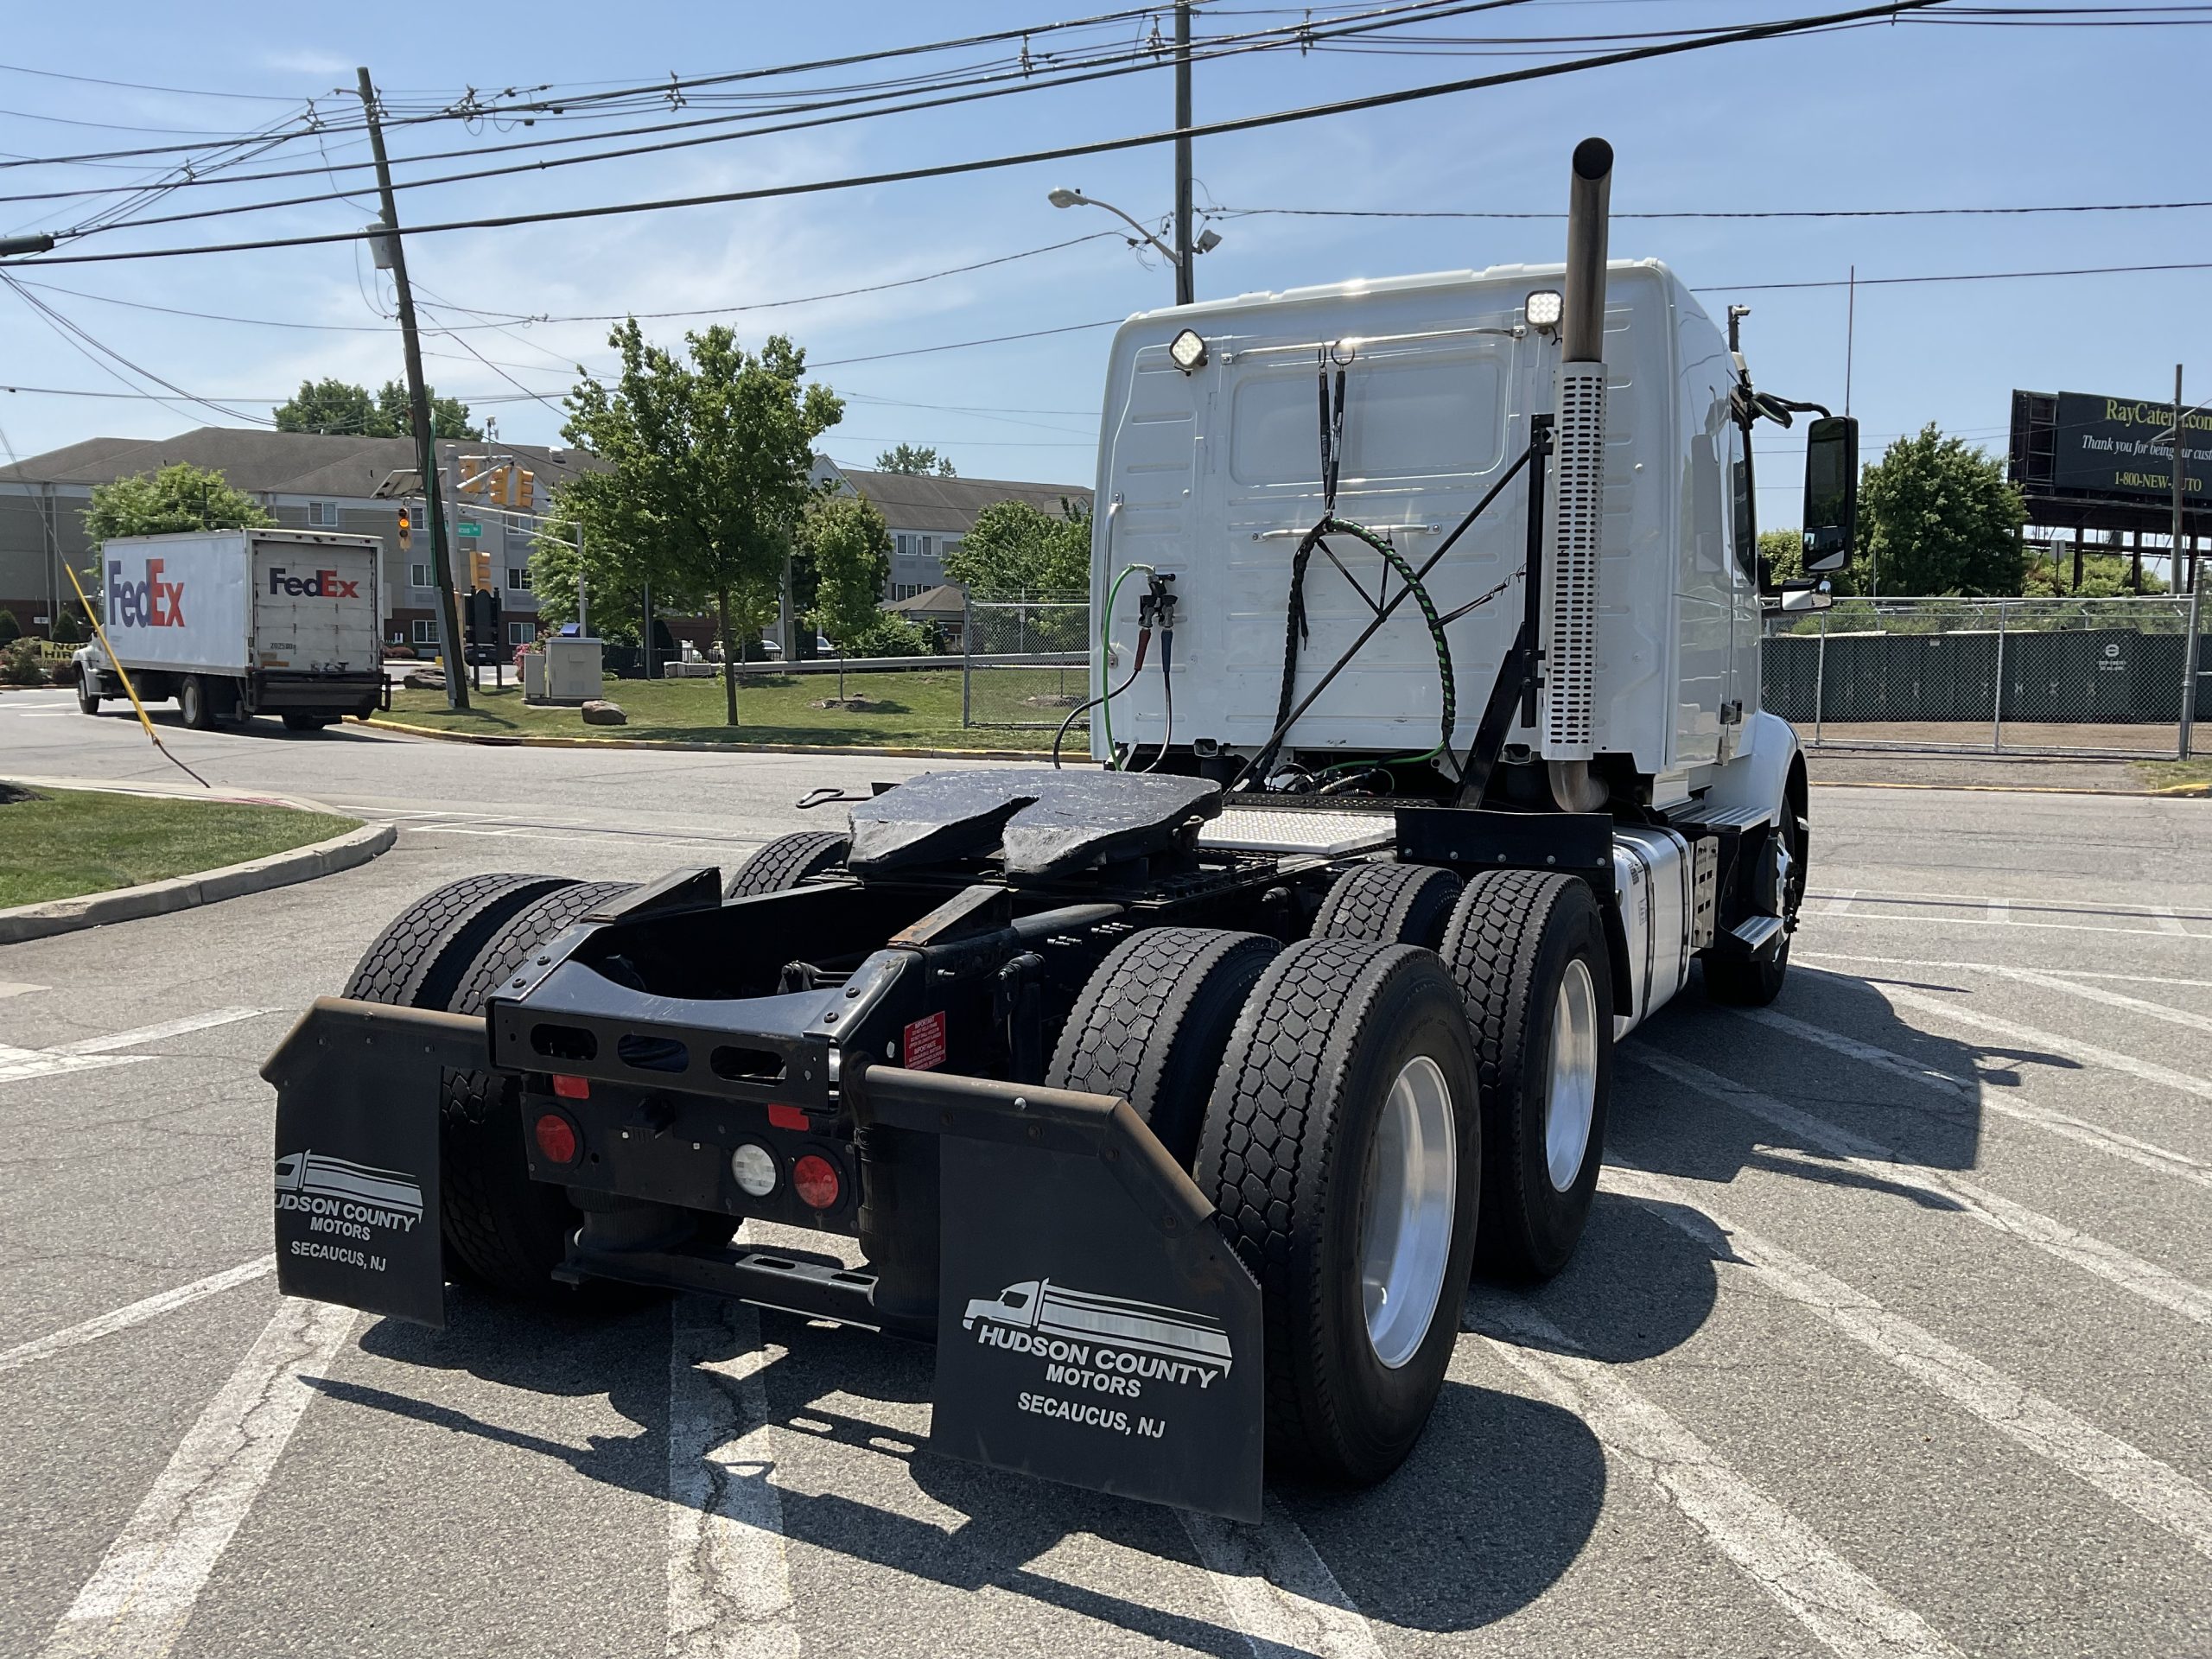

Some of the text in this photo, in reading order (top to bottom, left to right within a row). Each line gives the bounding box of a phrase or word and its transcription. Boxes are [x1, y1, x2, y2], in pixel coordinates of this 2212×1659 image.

[2082, 435, 2113, 451] Thank
[2113, 441, 2133, 454] you
[2133, 439, 2149, 456] for
[2150, 441, 2174, 461] being
[2182, 448, 2193, 458] ur
[108, 558, 185, 628] FedEx
[270, 567, 359, 598] FedEx
[44, 650, 73, 658] HIR
[275, 1192, 416, 1232] UDSON COUNTY
[310, 1217, 371, 1241] MOTORS
[290, 1241, 386, 1272] SECAUCUS, NJ
[977, 1325, 1218, 1389] HUDSON COUNTY
[1045, 1363, 1141, 1397] MOTORS
[1018, 1392, 1166, 1439] SECAUCUS, NJ
